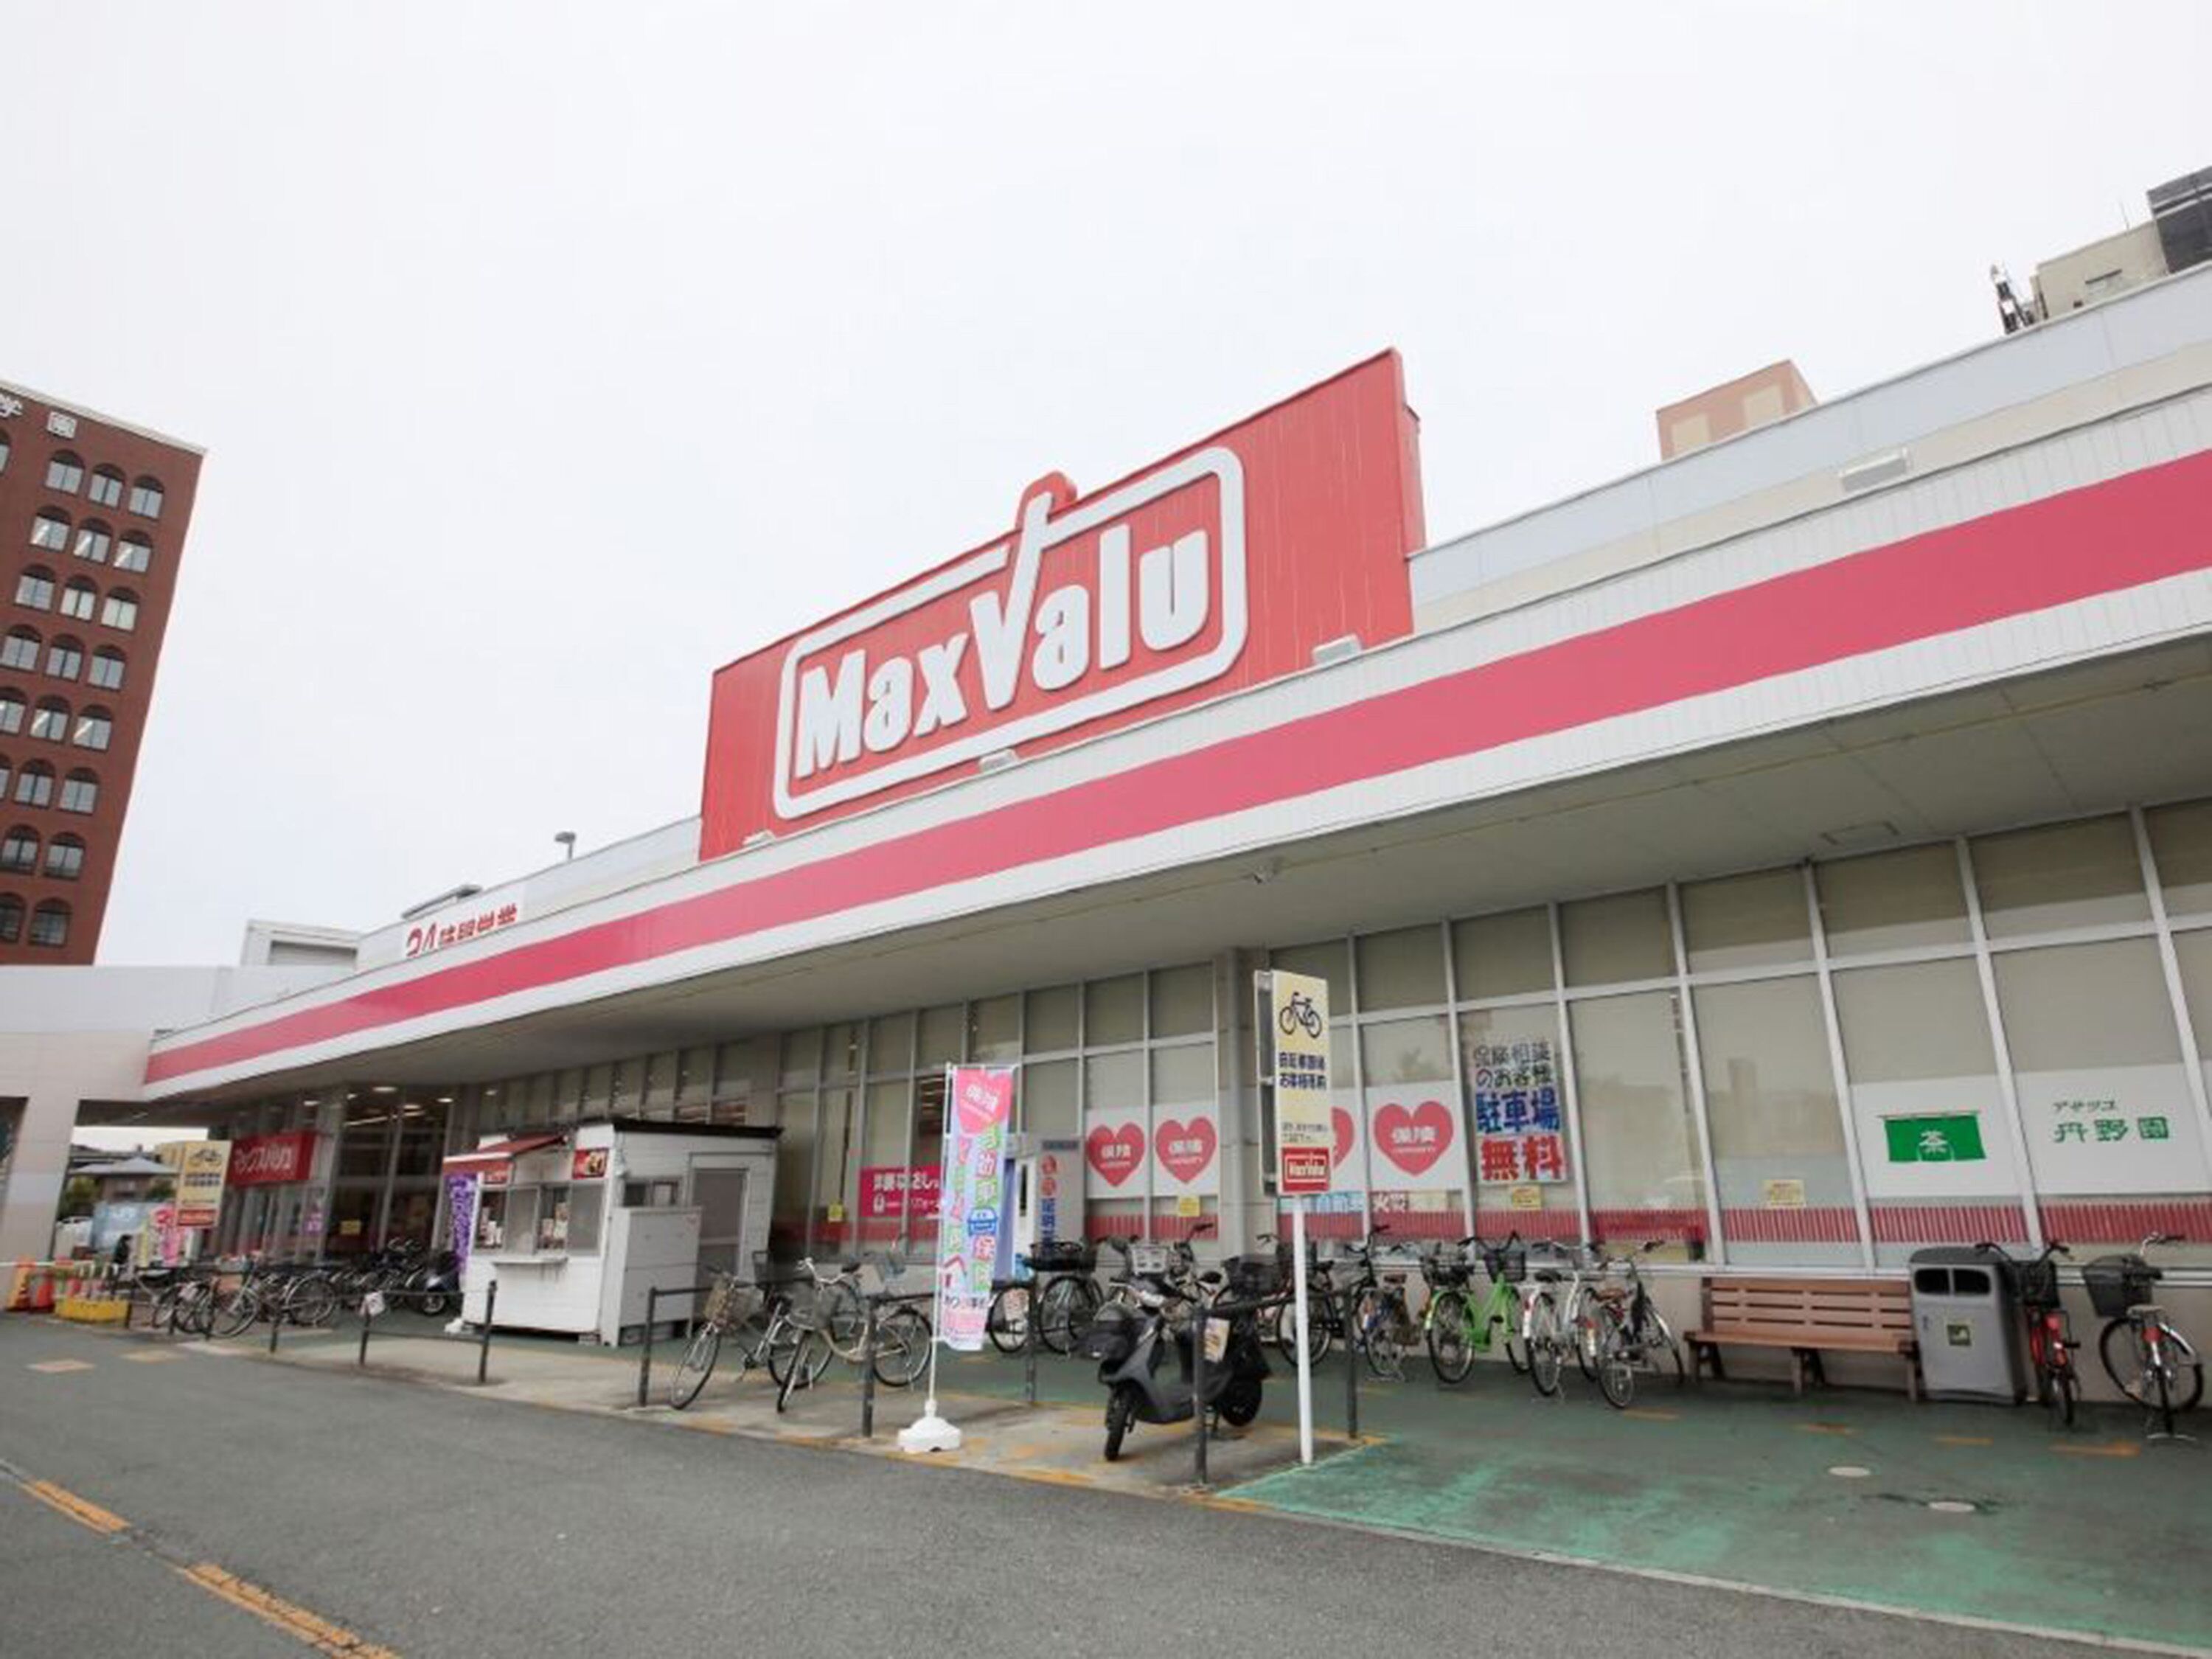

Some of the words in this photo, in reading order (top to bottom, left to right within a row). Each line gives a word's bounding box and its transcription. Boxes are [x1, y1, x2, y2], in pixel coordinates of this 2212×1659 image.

[795, 490, 1208, 779] MaxValu
[1476, 1086, 1560, 1134] 駐車場
[1481, 1135, 1562, 1180] 無料
[1919, 1130, 1949, 1154] 茶
